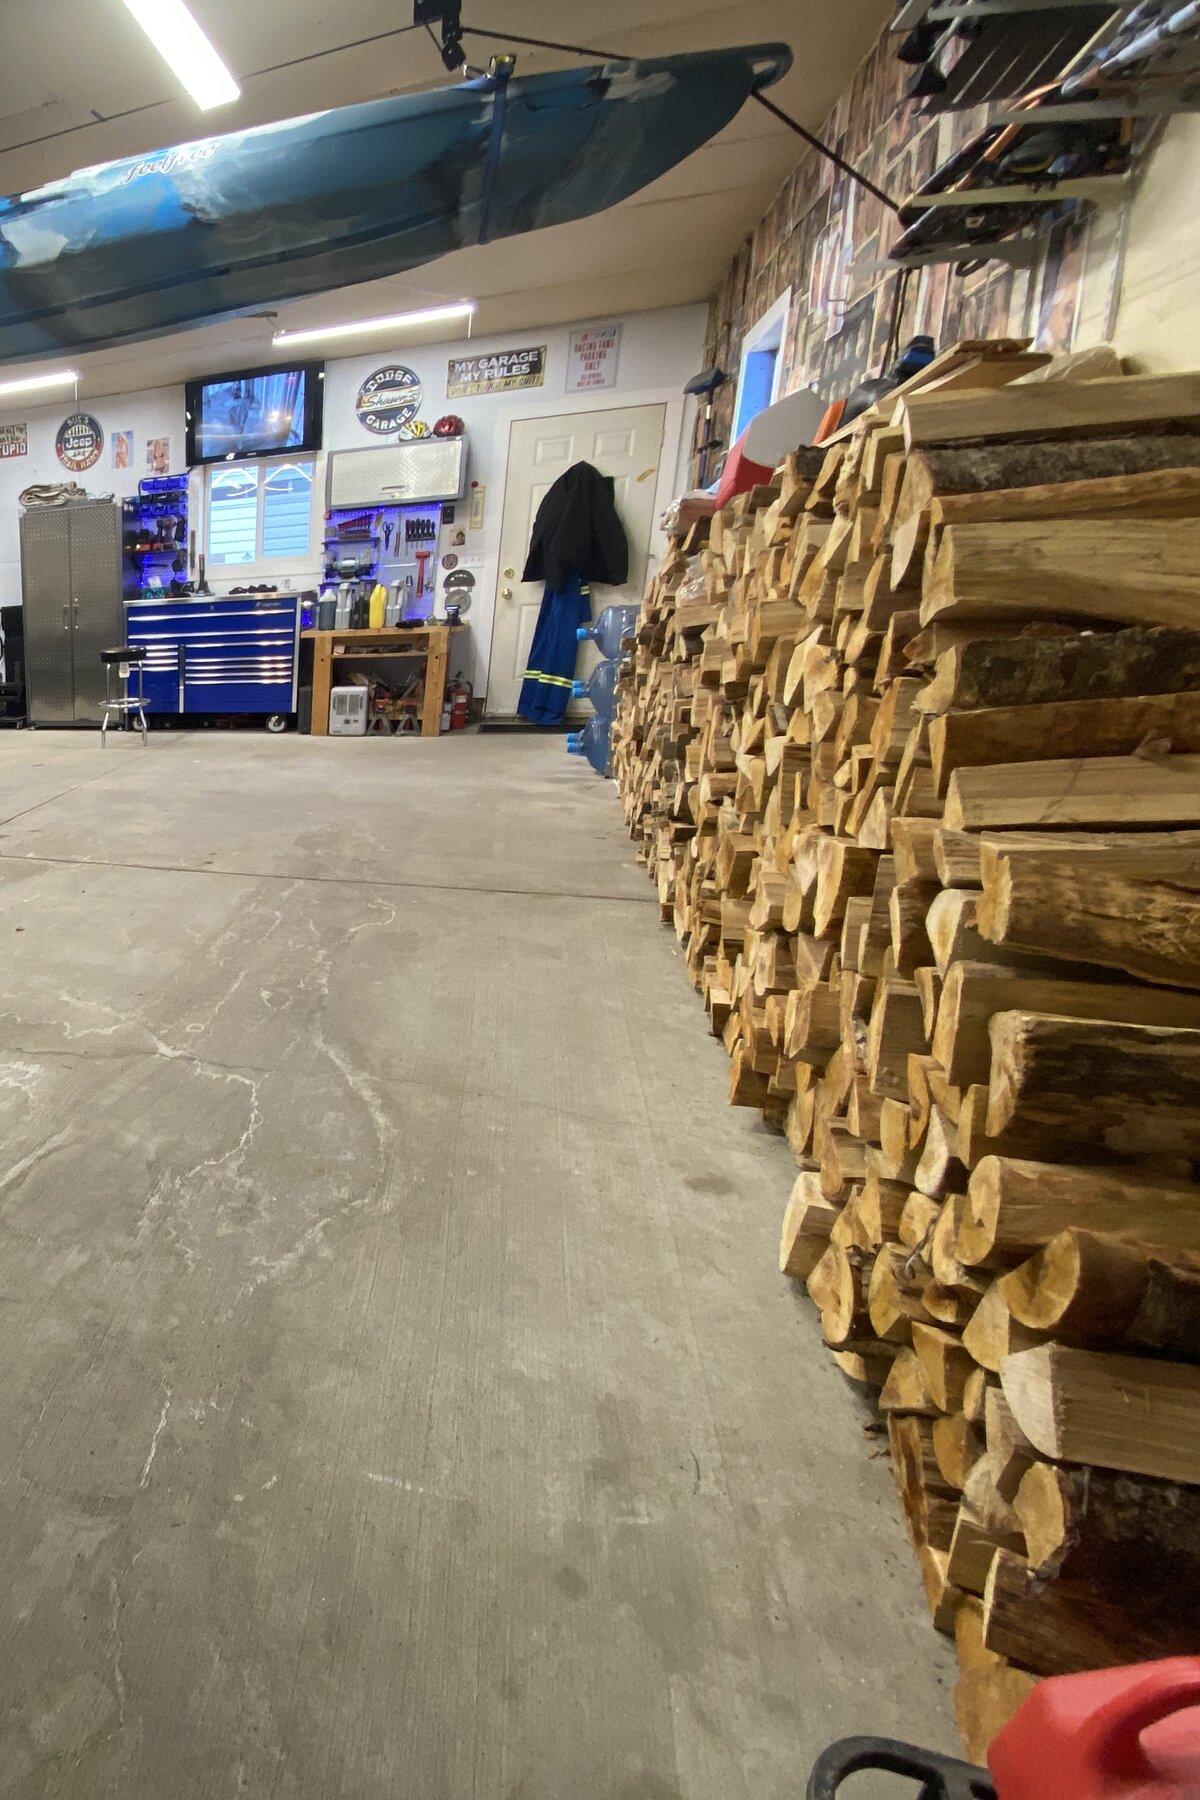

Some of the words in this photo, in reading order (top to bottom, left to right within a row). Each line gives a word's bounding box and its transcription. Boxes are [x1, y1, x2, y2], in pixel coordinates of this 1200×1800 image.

[454, 361, 475, 372] MY
[478, 351, 539, 369] GARAGE
[366, 370, 413, 391] DODGE
[460, 371, 481, 382] MY
[484, 363, 531, 379] RULES
[366, 408, 413, 430] GARAGE
[65, 437, 92, 449] Jeep
